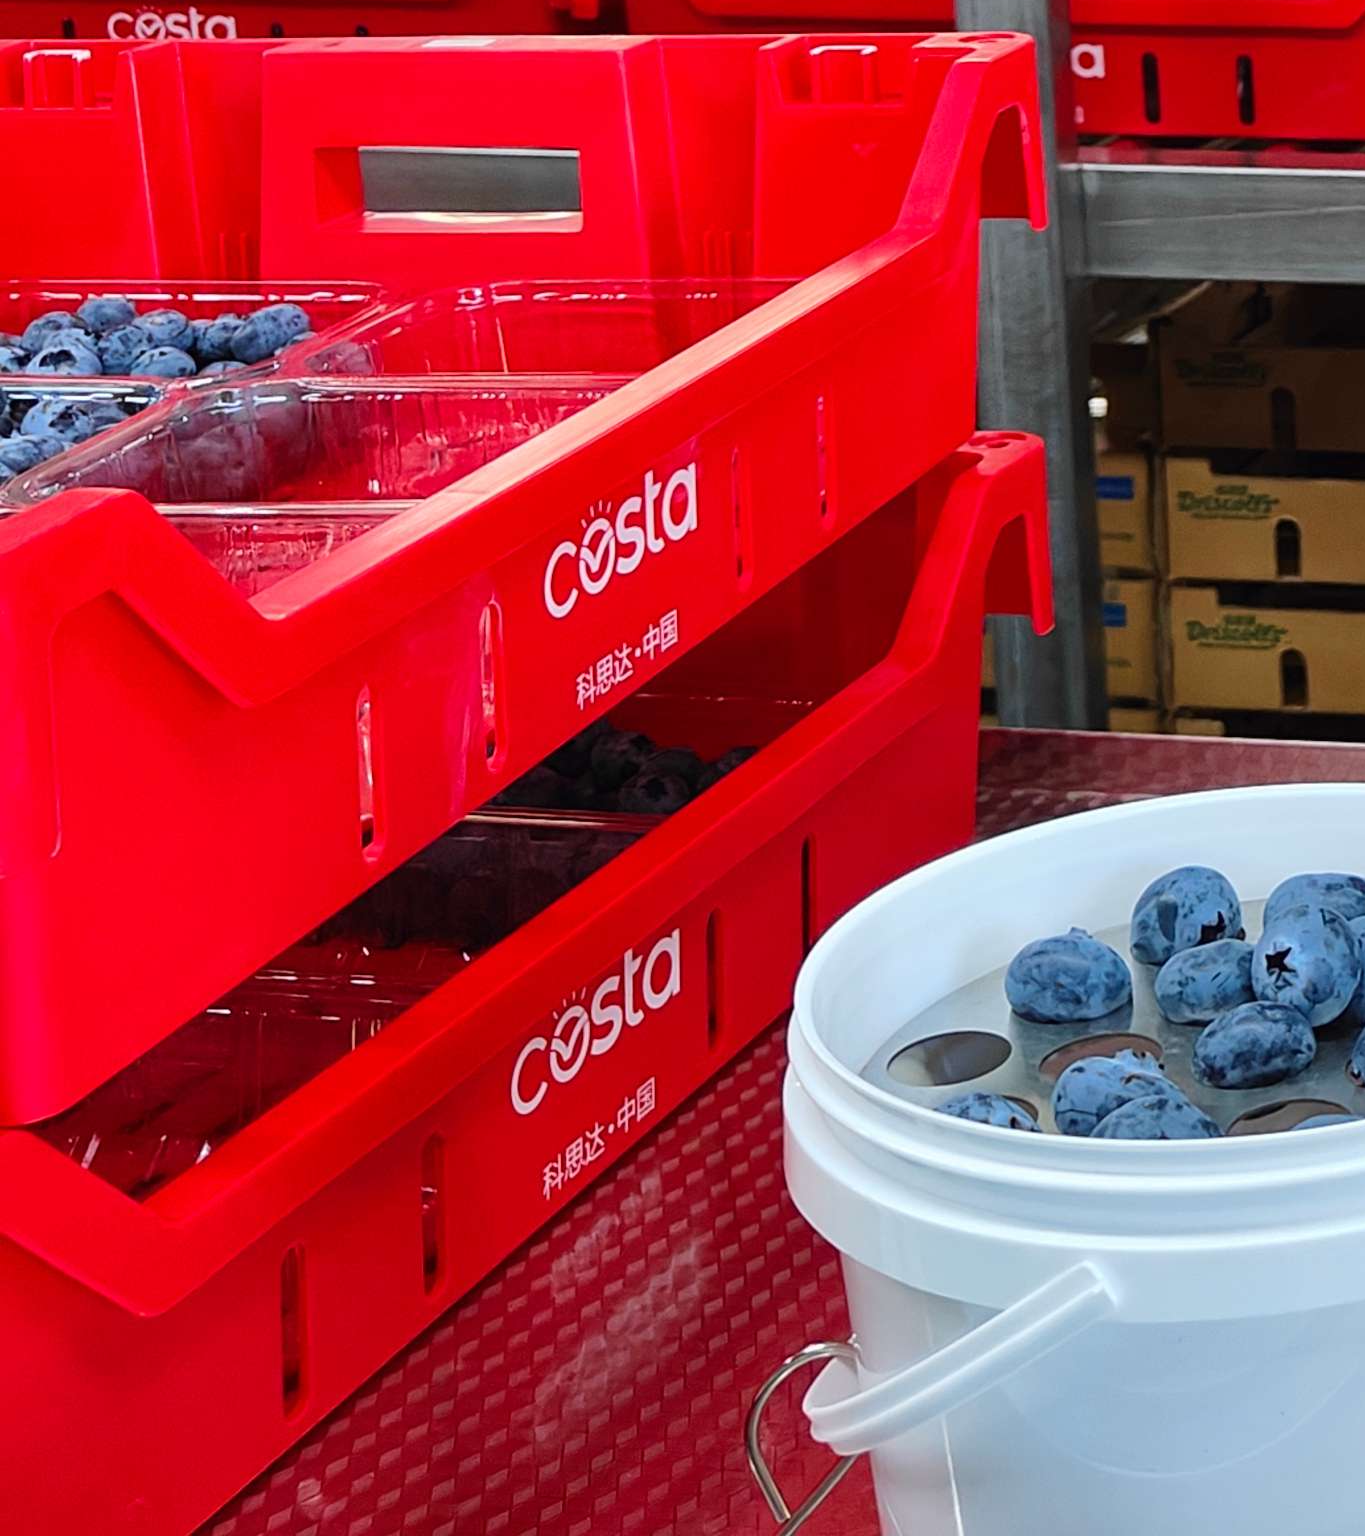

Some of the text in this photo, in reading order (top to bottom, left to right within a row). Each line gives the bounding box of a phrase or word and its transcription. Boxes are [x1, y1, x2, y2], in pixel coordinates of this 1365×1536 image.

[107, 5, 237, 40] costa
[544, 462, 698, 619] costa
[575, 609, 679, 710] 科思达·中国
[510, 927, 681, 1115] costa
[541, 1076, 656, 1200] 科思达·中国
